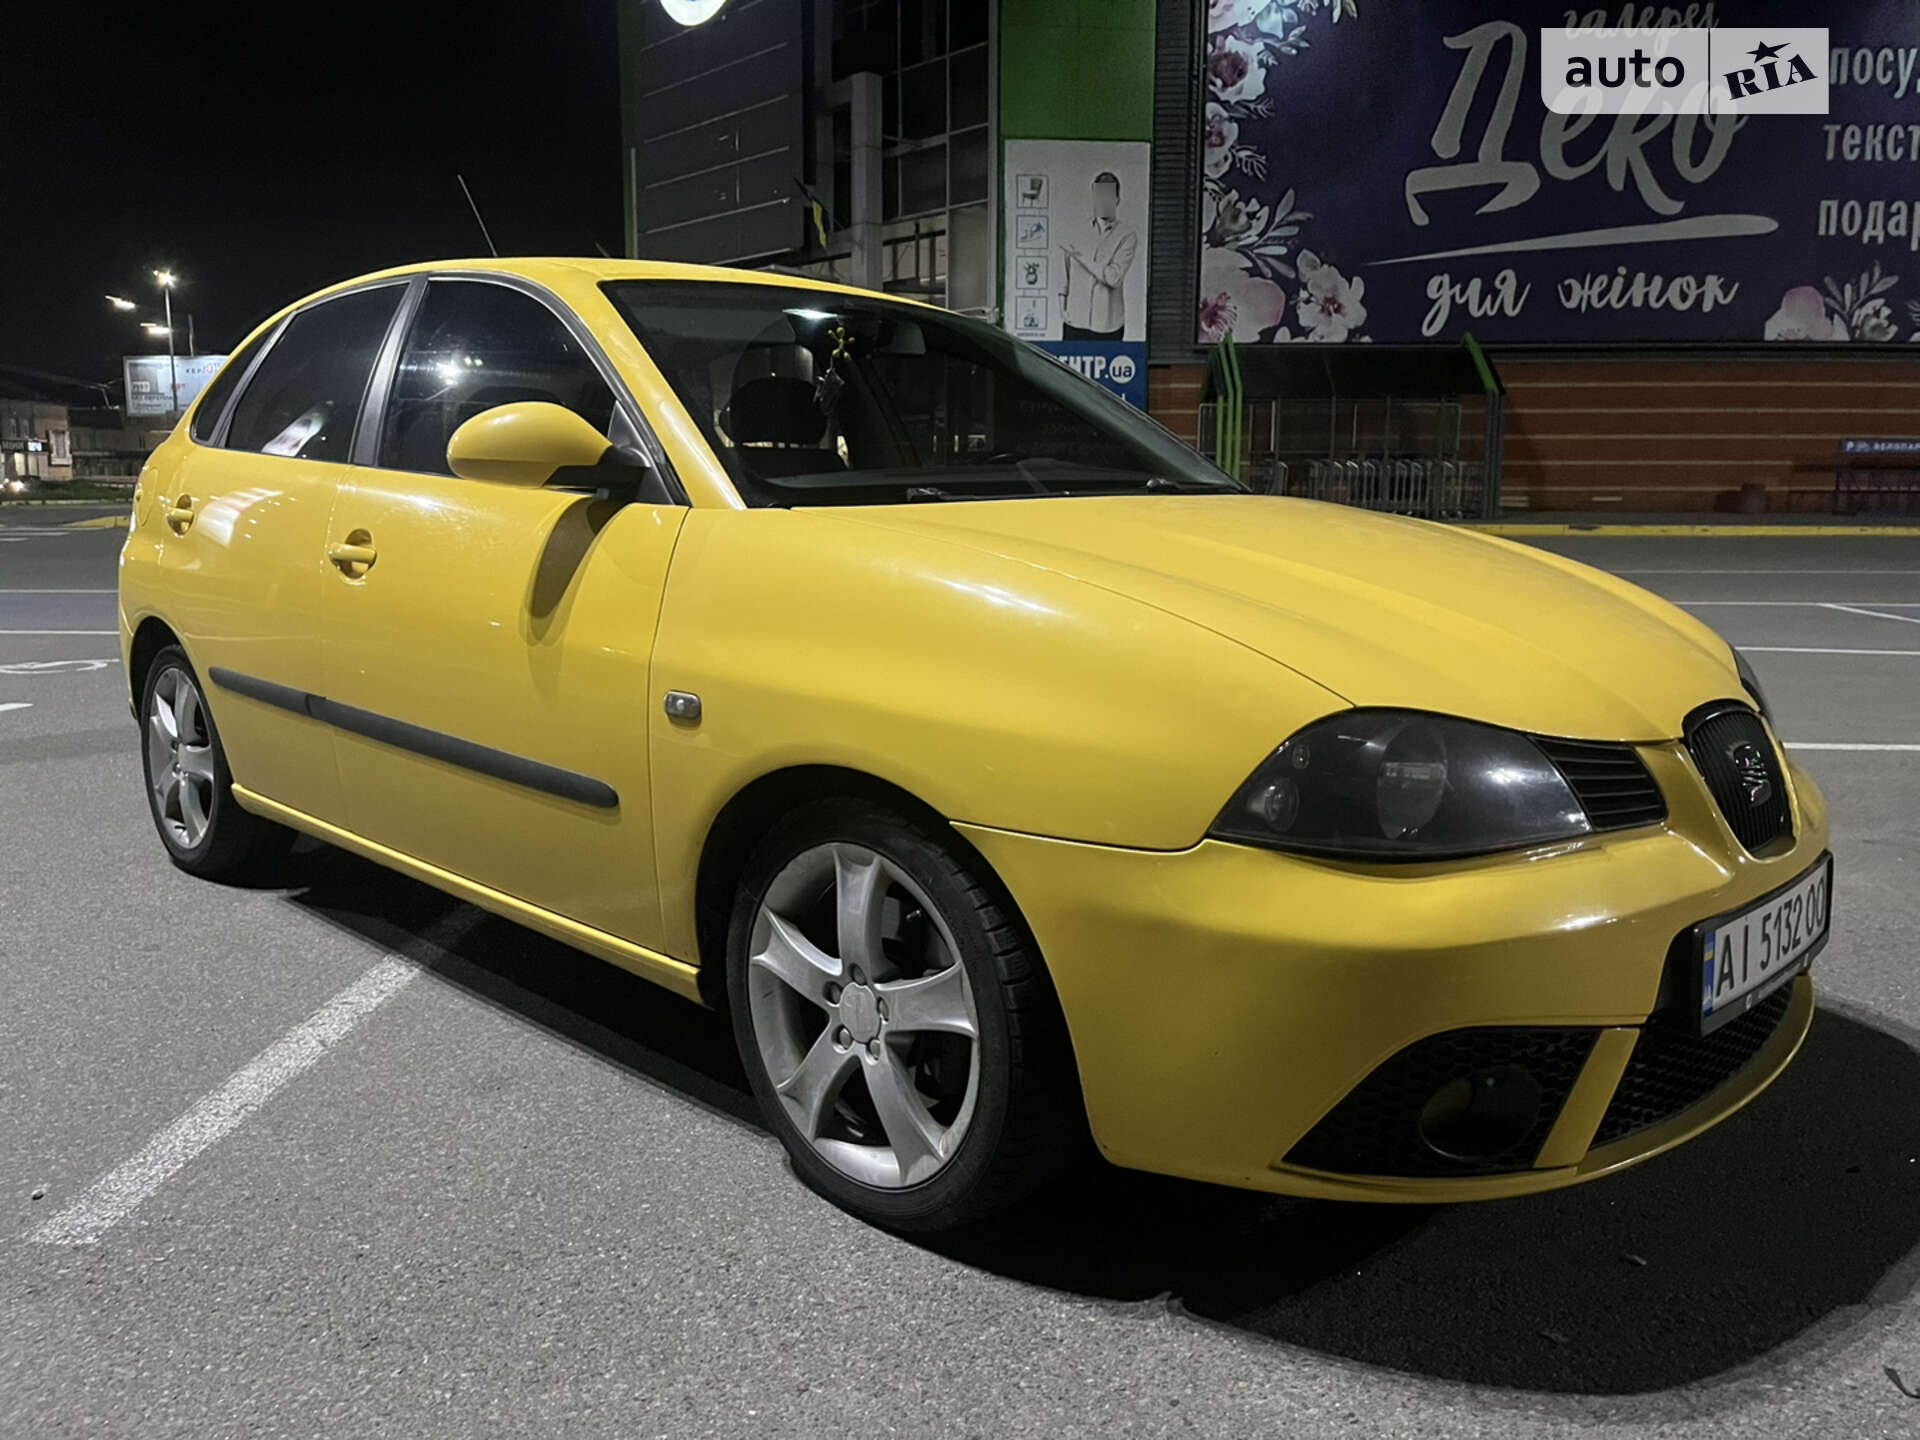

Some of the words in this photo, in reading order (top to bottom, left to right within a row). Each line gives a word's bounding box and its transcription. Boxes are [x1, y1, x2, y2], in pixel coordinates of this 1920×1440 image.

[1829, 47, 1920, 99] посу
[1405, 20, 1748, 227] Деко
[1421, 268, 1532, 337] для
[1557, 265, 1740, 313] жінок
[1715, 924, 1749, 998] AI
[1760, 894, 1803, 971] 5132
[1805, 876, 1825, 936] OO
